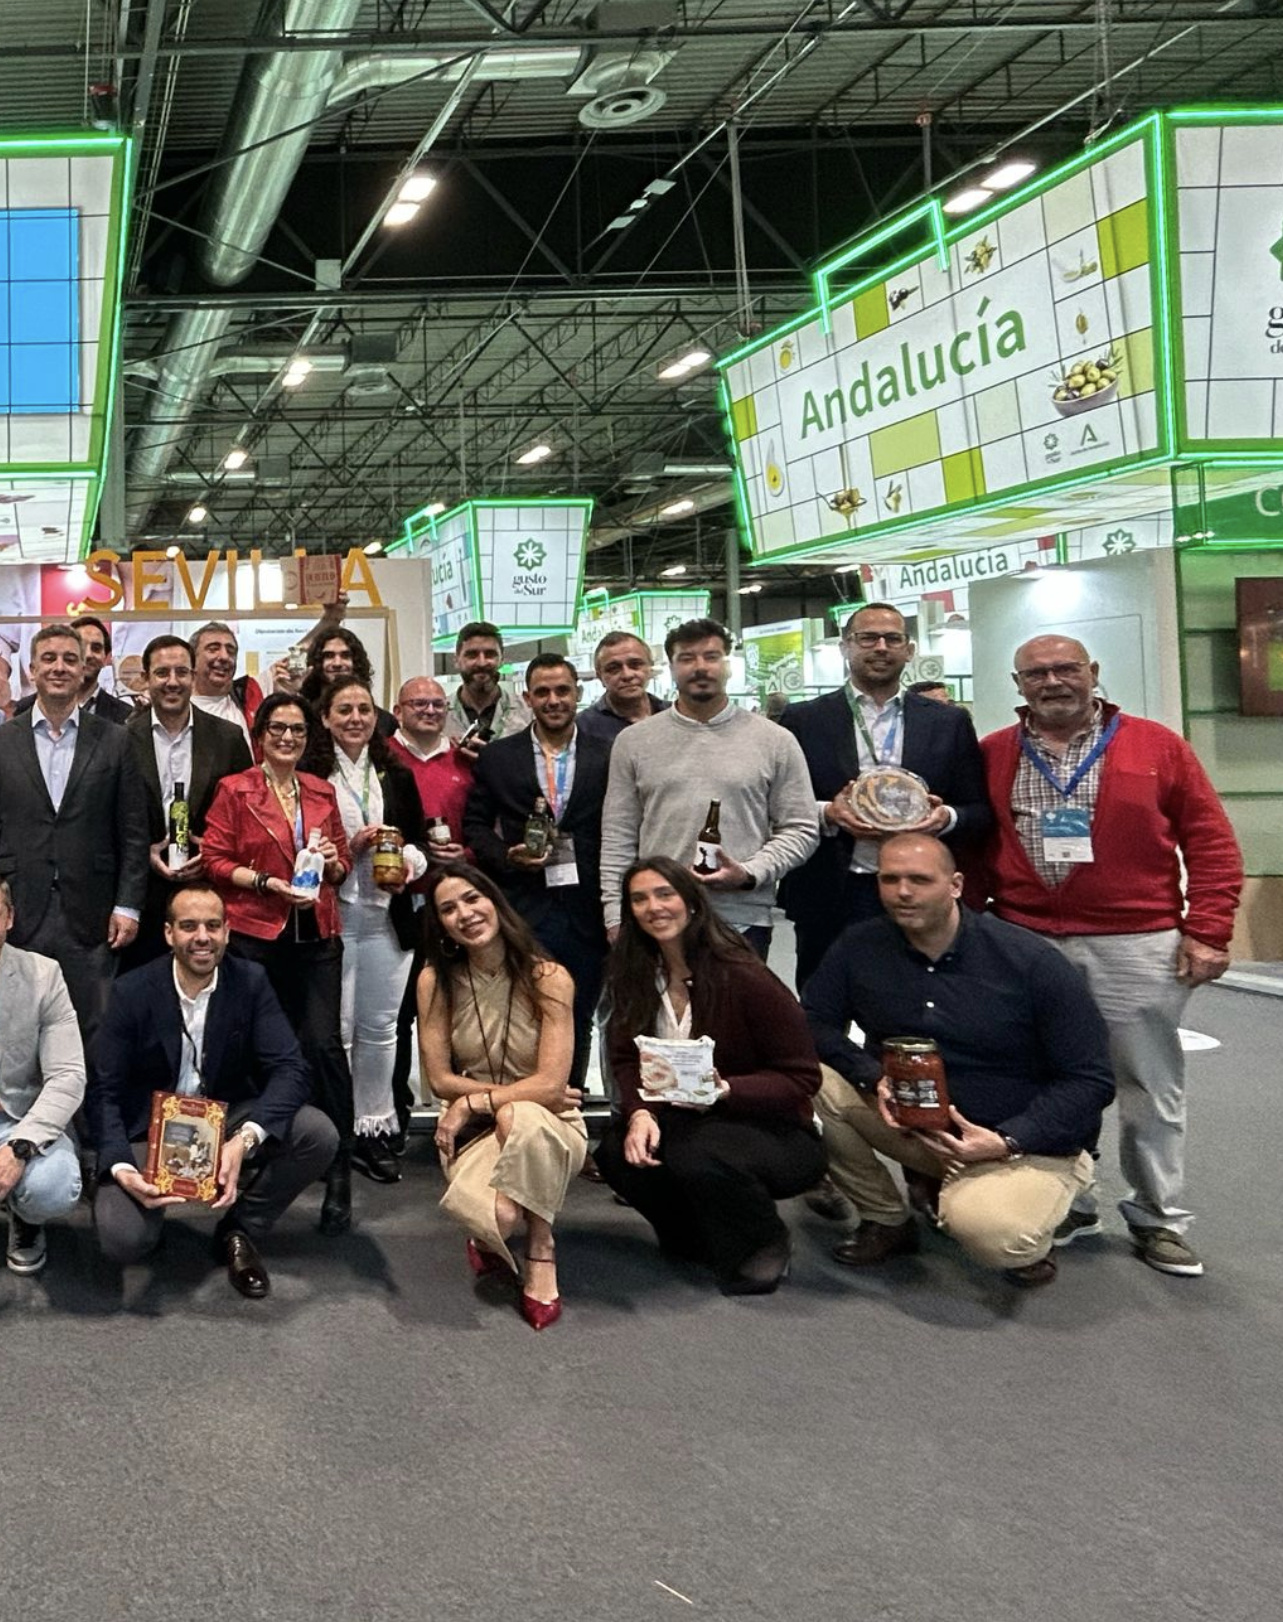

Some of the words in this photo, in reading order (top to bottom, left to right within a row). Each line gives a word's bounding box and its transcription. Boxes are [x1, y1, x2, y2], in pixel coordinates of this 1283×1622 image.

[800, 297, 1027, 439] Andalucía
[85, 547, 384, 611] SEVILA
[512, 573, 547, 588] gusto
[523, 584, 547, 596] Sur
